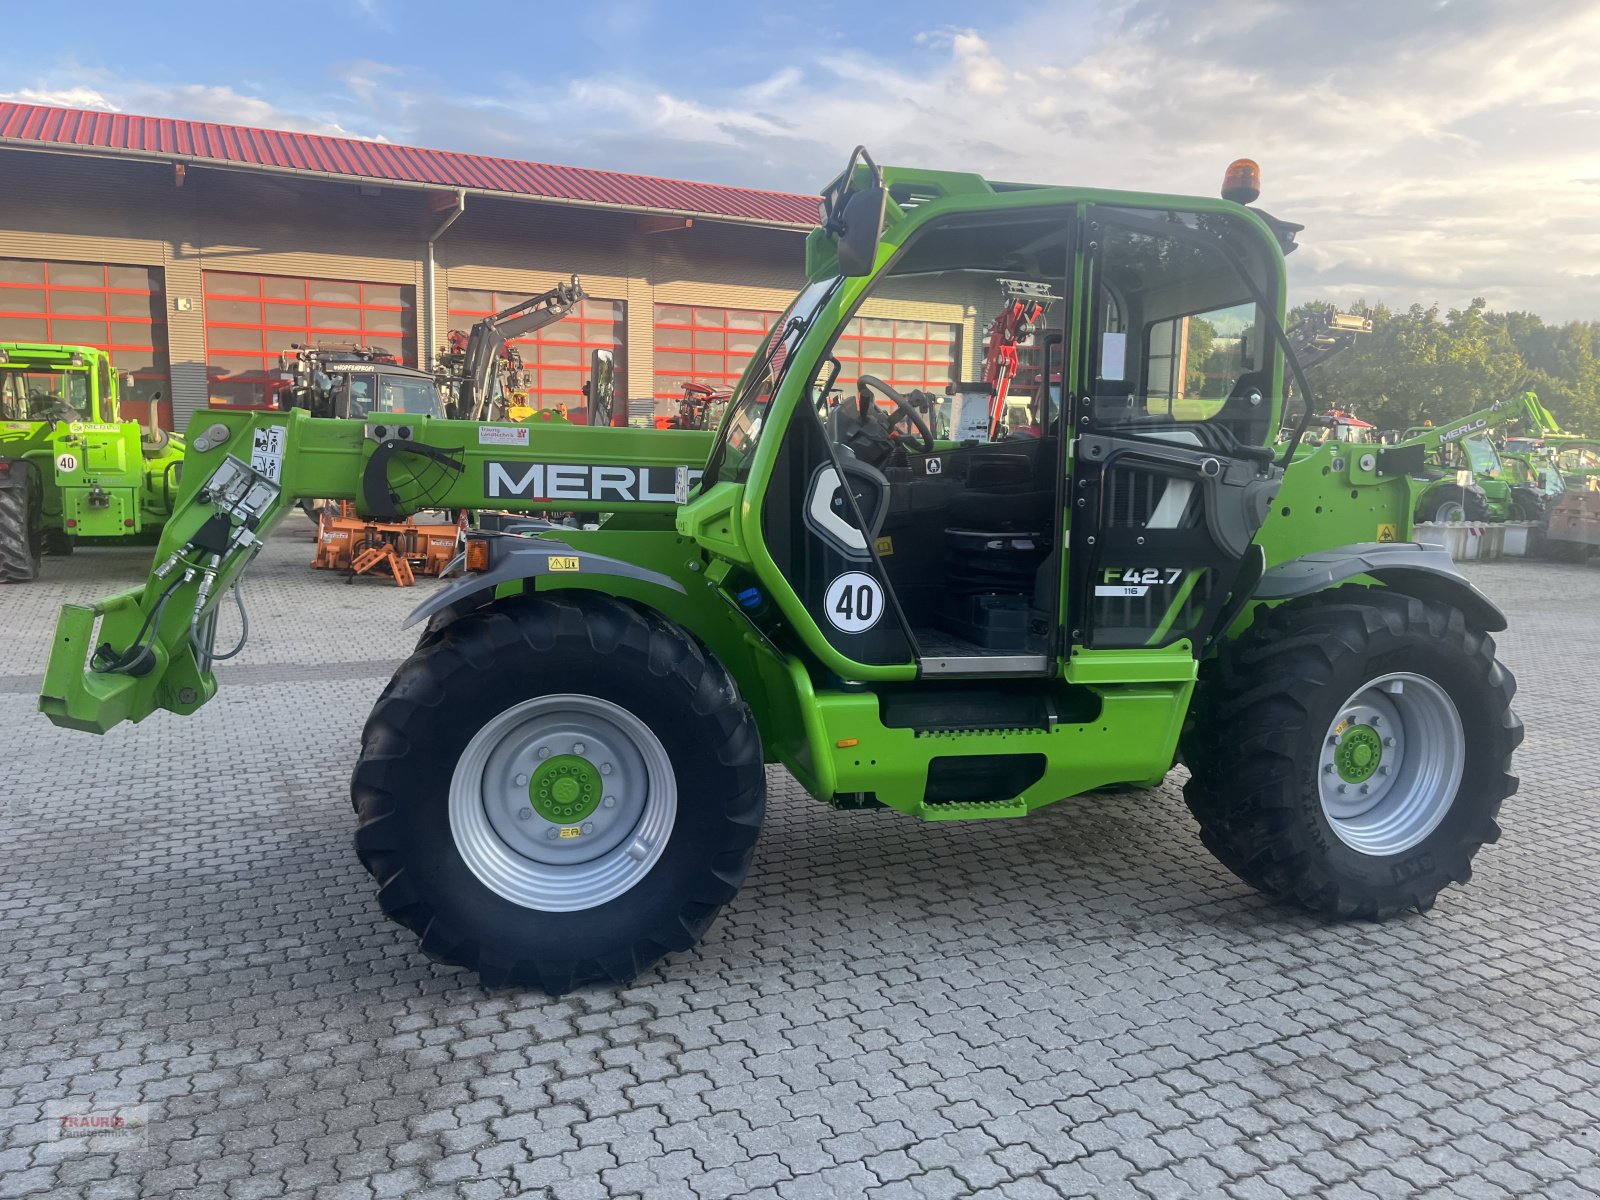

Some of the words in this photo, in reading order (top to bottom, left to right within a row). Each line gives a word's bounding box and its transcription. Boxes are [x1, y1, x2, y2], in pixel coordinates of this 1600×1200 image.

[1439, 419, 1487, 443] MERLO
[60, 457, 74, 469] 40
[1124, 587, 1138, 595] 116
[836, 584, 873, 621] 40
